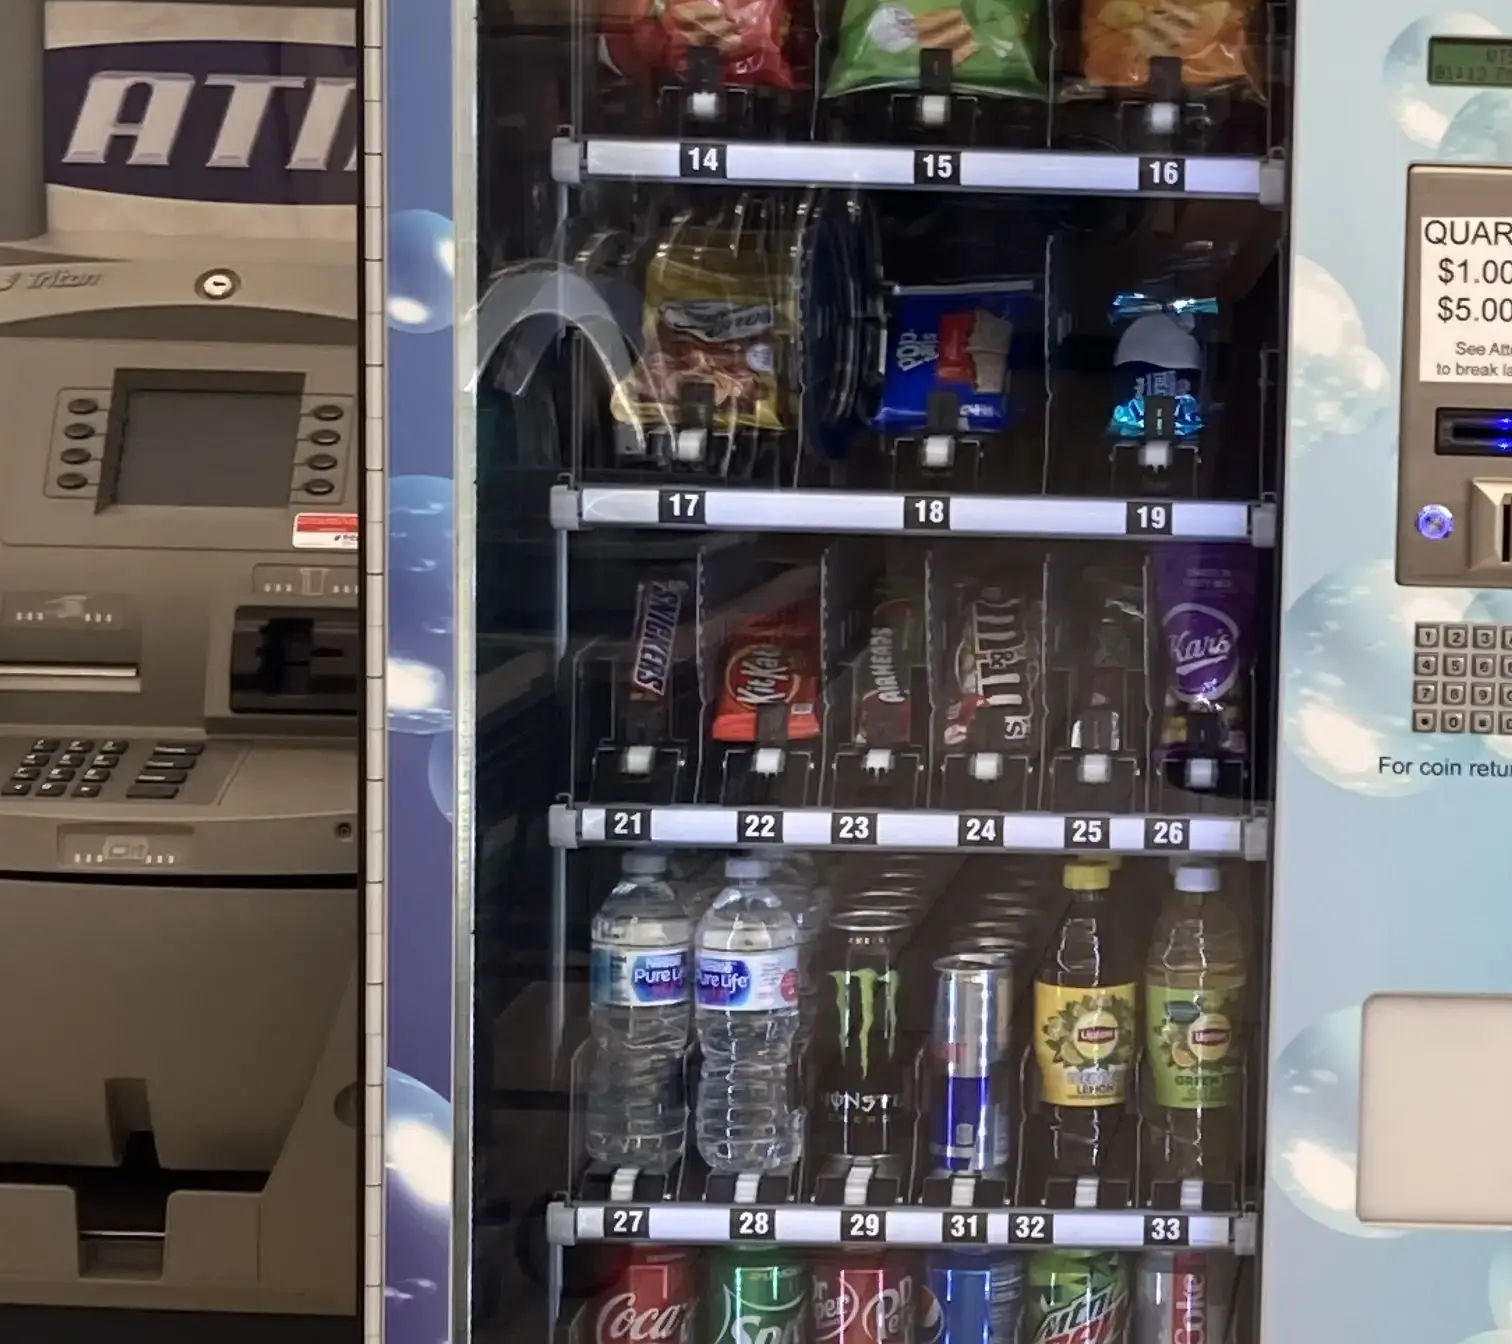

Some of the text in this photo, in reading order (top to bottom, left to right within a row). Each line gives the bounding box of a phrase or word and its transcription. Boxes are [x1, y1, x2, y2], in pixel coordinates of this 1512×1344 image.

[688, 149, 718, 173] 14
[923, 155, 953, 179] 15
[1149, 161, 1179, 184] 16
[1455, 342, 1486, 357] See
[1436, 363, 1451, 376] to
[1455, 362, 1499, 377] break
[669, 493, 699, 517] 17
[914, 499, 945, 524] 18
[1137, 506, 1166, 529] 19
[635, 581, 682, 696] SNICKERS
[1378, 757, 1413, 776] For
[1419, 758, 1462, 777] coin
[613, 812, 642, 836] 21
[745, 814, 775, 837] 22
[838, 816, 869, 839] 23
[966, 818, 996, 841] 24
[1072, 819, 1102, 843] 25
[1153, 821, 1183, 844] 26
[634, 969, 671, 984] Pure
[721, 974, 748, 994] Life
[612, 1210, 642, 1233] 27
[739, 1212, 769, 1235] 28
[850, 1213, 880, 1236] 29
[951, 1213, 980, 1237] 31
[1015, 1215, 1045, 1238] 32
[1152, 1216, 1181, 1240] 33
